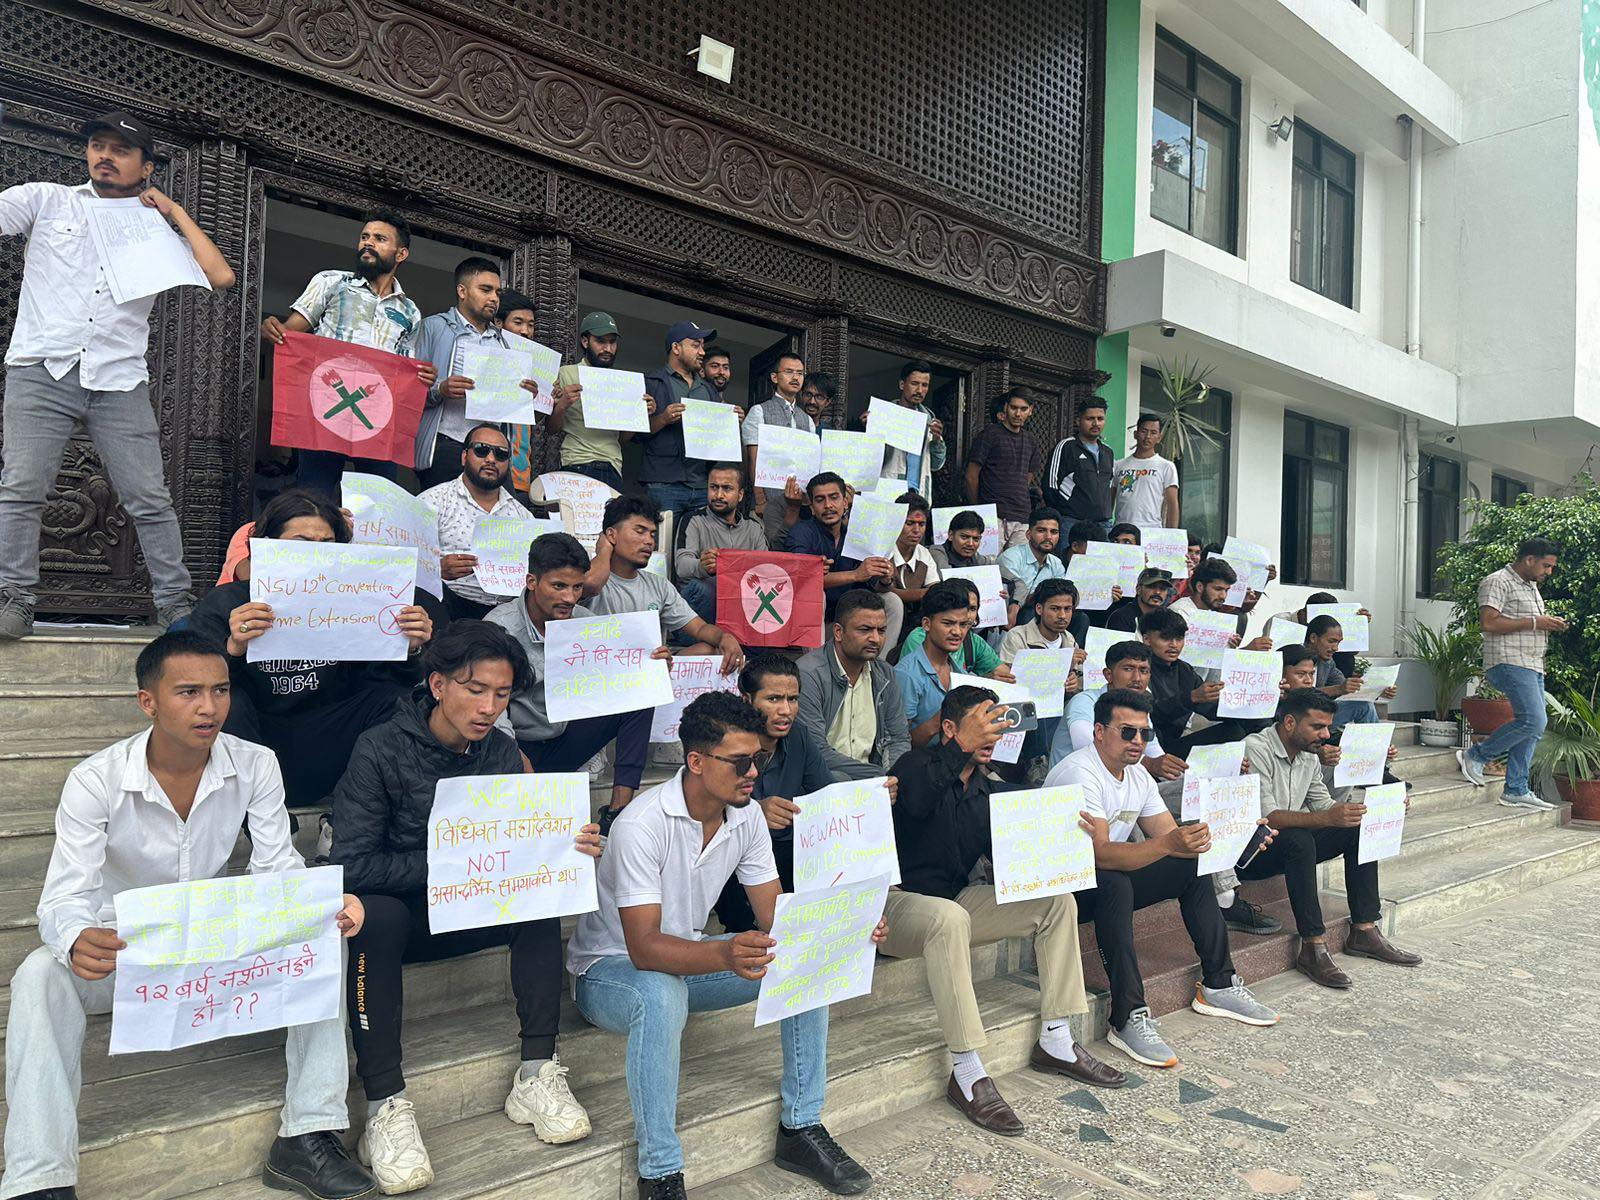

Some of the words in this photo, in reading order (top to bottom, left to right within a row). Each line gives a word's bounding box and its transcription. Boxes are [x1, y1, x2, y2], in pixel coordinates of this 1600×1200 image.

[1118, 468, 1136, 477] JUST
[1135, 468, 1147, 477] DO
[257, 576, 298, 596] NSU
[326, 578, 393, 596] Convention
[307, 607, 377, 631] Extension
[270, 671, 319, 694] 1964
[817, 813, 866, 842] WANT
[467, 850, 511, 875] NOT
[357, 952, 366, 973] new
[356, 975, 366, 1013] balance
